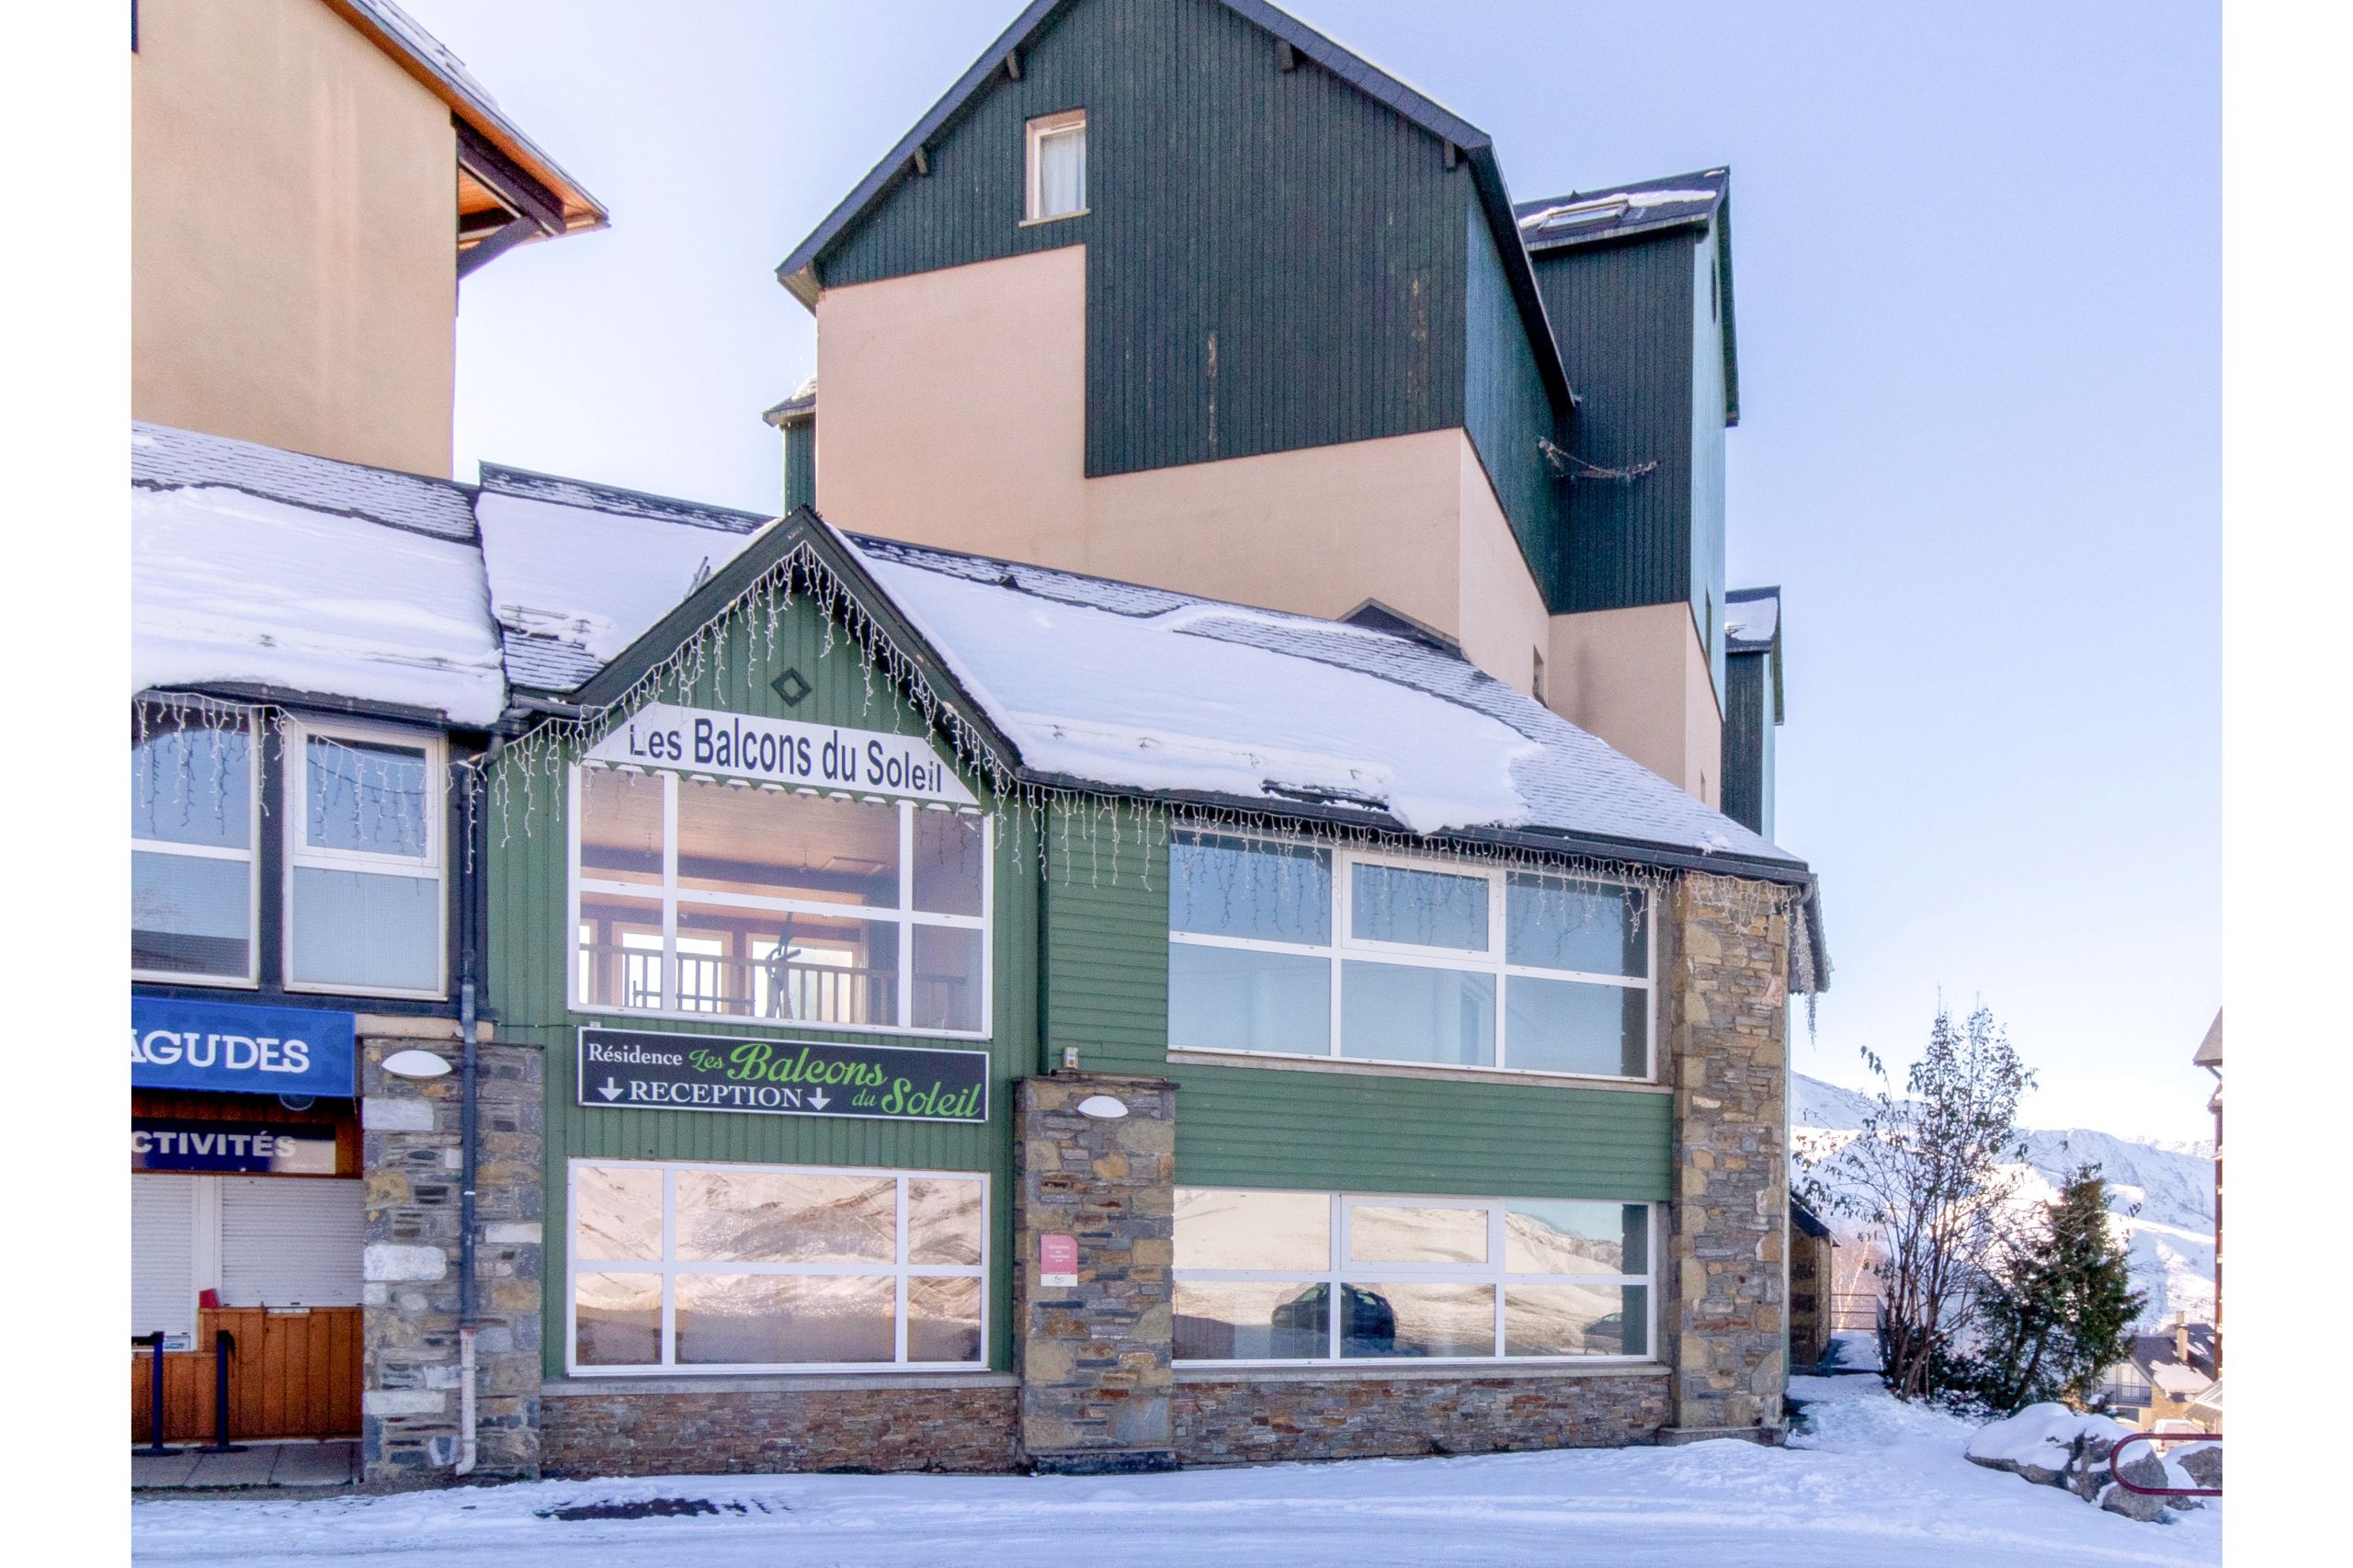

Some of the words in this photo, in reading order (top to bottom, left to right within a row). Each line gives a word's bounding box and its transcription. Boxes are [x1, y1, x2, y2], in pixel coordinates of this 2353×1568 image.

[630, 723, 682, 761] Les
[694, 717, 812, 777] Balcons
[822, 729, 856, 782] du
[867, 739, 941, 792] Soleil
[588, 1043, 683, 1066] Résidence
[688, 1049, 724, 1073] Les
[727, 1043, 888, 1086] Balcons
[629, 1080, 803, 1108] RECEPTION
[852, 1088, 877, 1107] du
[881, 1077, 983, 1118] Soleil
